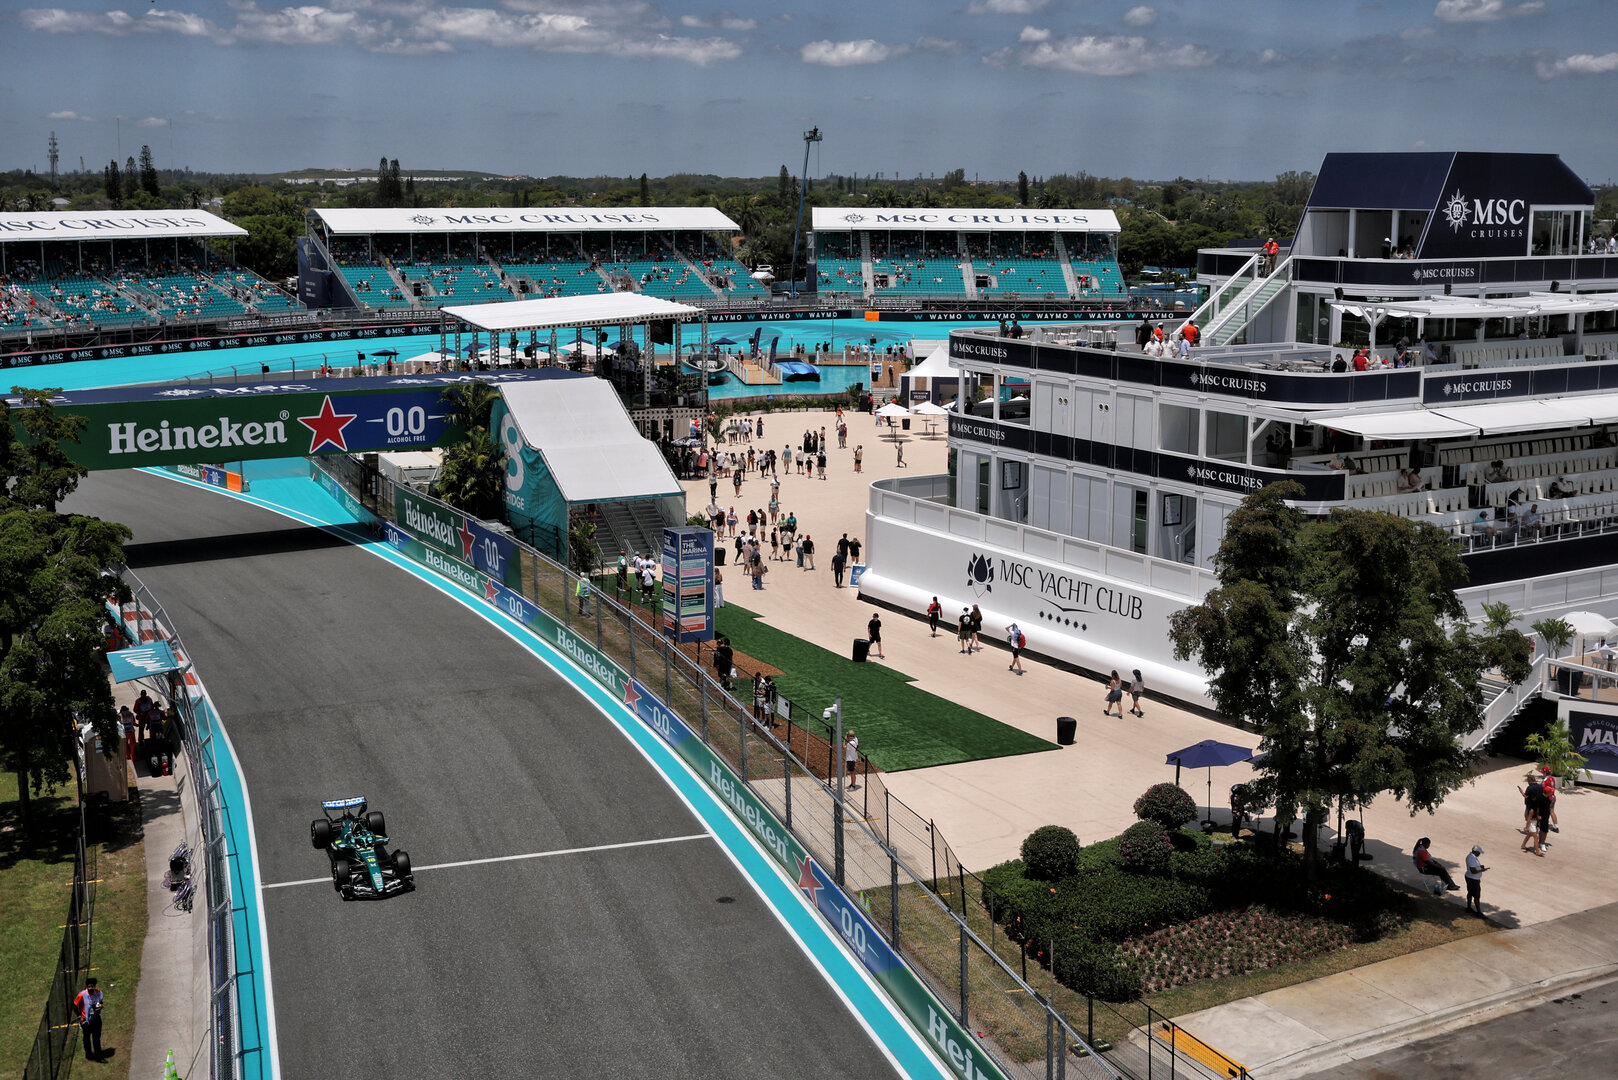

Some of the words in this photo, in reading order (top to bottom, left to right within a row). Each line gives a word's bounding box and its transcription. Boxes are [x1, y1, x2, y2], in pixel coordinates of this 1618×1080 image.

[444, 214, 513, 224] MSC
[520, 214, 661, 224] CRUISES
[875, 214, 939, 224] MSC
[948, 214, 1089, 224] CRUISES
[1472, 199, 1524, 225] MSC
[0, 220, 56, 231] SC
[58, 217, 207, 230] CRUISES
[1471, 230, 1523, 238] CRUISES
[1422, 268, 1438, 278] MSC
[1440, 268, 1475, 278] CRUISES
[958, 343, 974, 354] MSC
[975, 344, 1008, 358] CRUISES
[1199, 374, 1222, 388] MSC
[1224, 376, 1266, 392] CRUISES
[1453, 381, 1472, 394] MSC
[1473, 379, 1512, 393] CRUISES
[387, 406, 425, 436] 0.0
[957, 423, 973, 434] MSC
[973, 426, 1006, 441] CRUISES
[501, 413, 524, 491] 8
[1196, 465, 1217, 480] MSC
[1218, 469, 1263, 489] CRUISES
[1000, 559, 1033, 589] MSC
[1038, 570, 1092, 605] YACHT
[1096, 587, 1143, 620] CLUB
[1580, 728, 1618, 747] MA
[326, 798, 362, 807] aramco
[842, 907, 866, 953] 0.0
